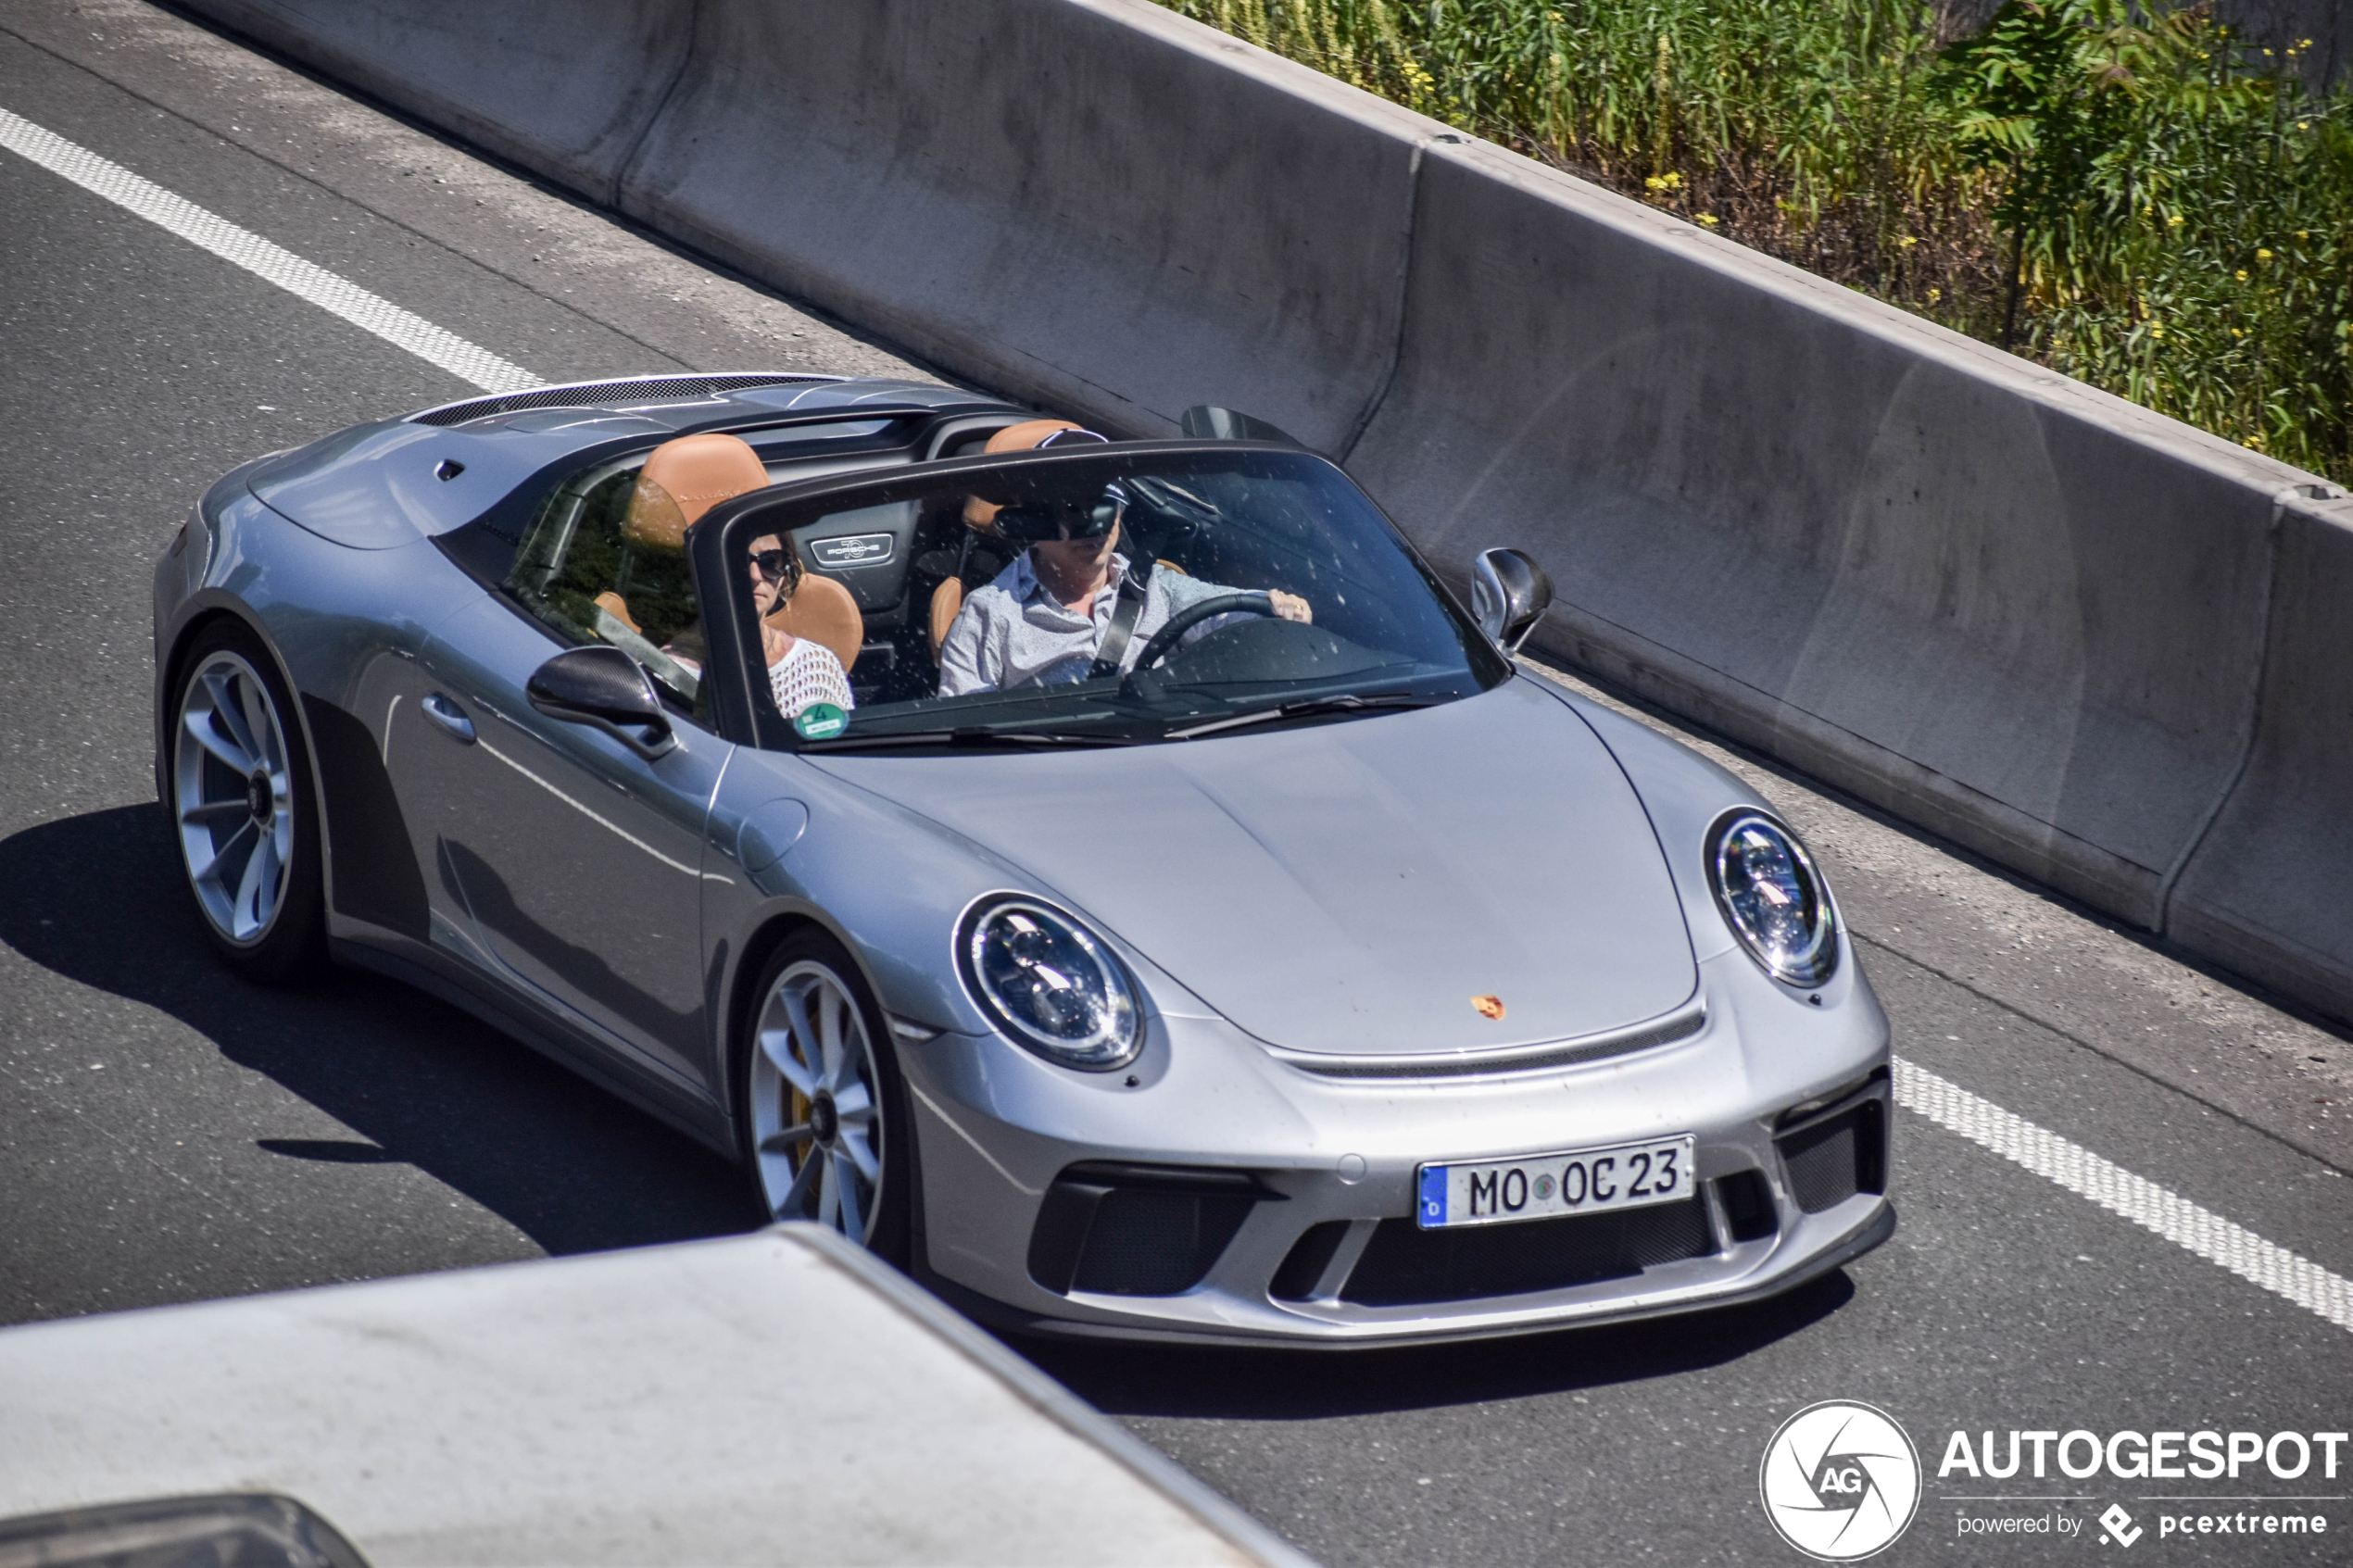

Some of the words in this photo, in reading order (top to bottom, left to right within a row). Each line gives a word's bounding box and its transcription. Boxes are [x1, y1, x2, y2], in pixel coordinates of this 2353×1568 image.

[814, 706, 827, 720] 4
[1470, 1168, 1528, 1216] MO
[1560, 1157, 1616, 1205] OC
[1629, 1148, 1677, 1198] 23
[1428, 1201, 1441, 1217] D
